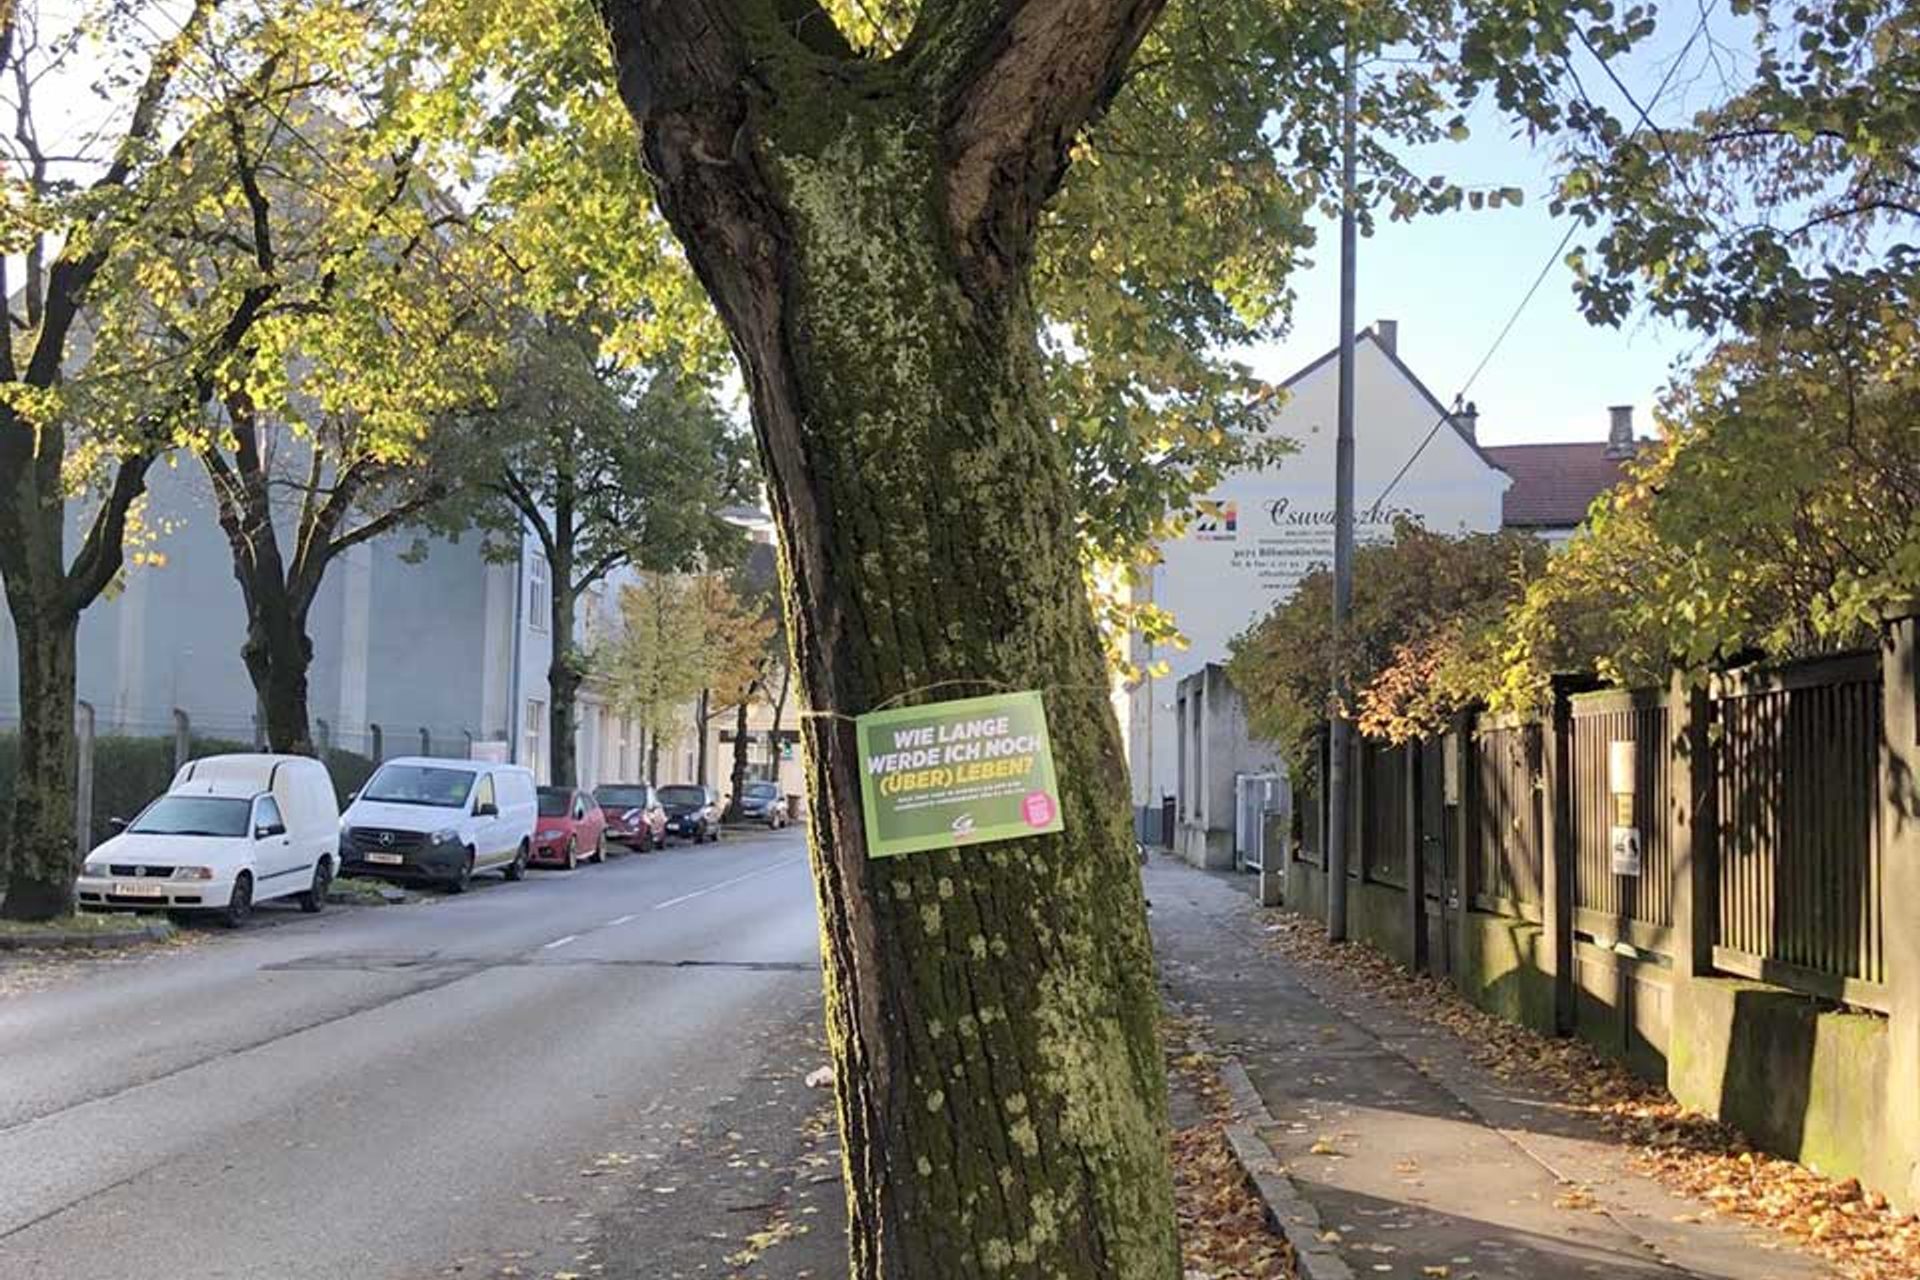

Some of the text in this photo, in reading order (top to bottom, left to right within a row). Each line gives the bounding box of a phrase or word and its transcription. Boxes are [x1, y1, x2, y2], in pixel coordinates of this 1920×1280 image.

[893, 717, 1009, 748] WIE LANGE
[867, 735, 1042, 774] WERDE ICH NOCH
